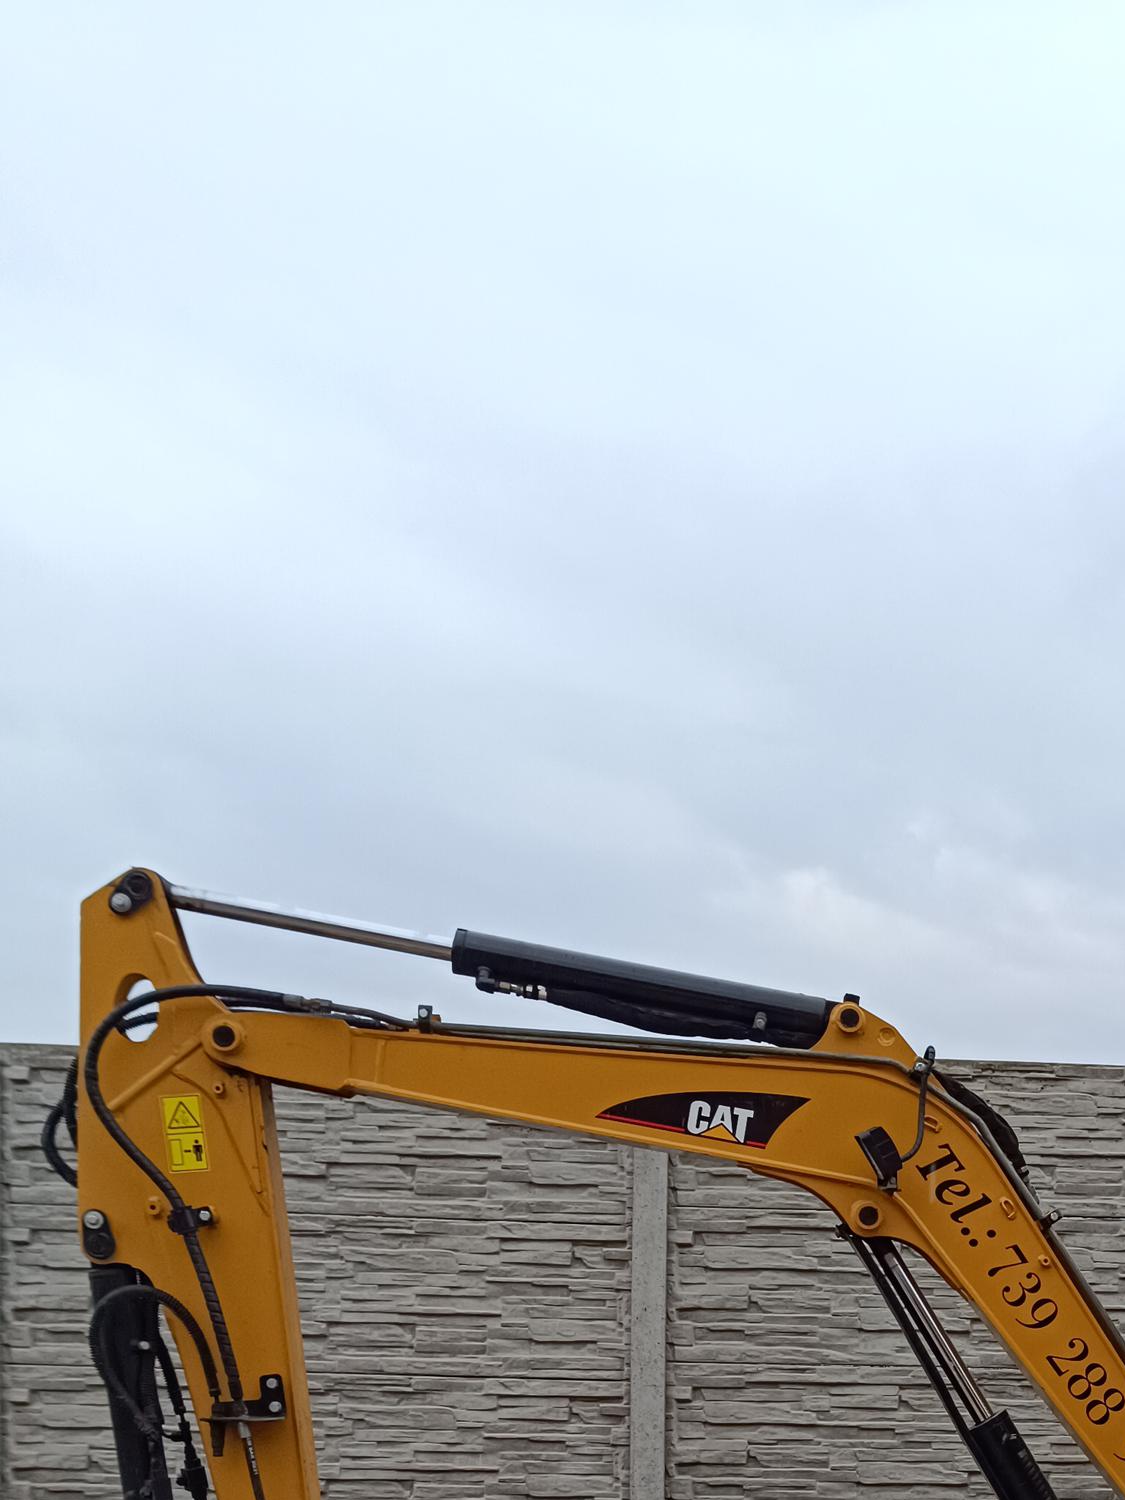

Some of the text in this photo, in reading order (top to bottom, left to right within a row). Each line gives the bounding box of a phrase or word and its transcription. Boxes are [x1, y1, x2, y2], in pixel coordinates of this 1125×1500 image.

[687, 1100, 755, 1143] CAT
[916, 1143, 997, 1247] Tel.:
[988, 1244, 1058, 1329] 739
[1046, 1337, 1125, 1426] 288
